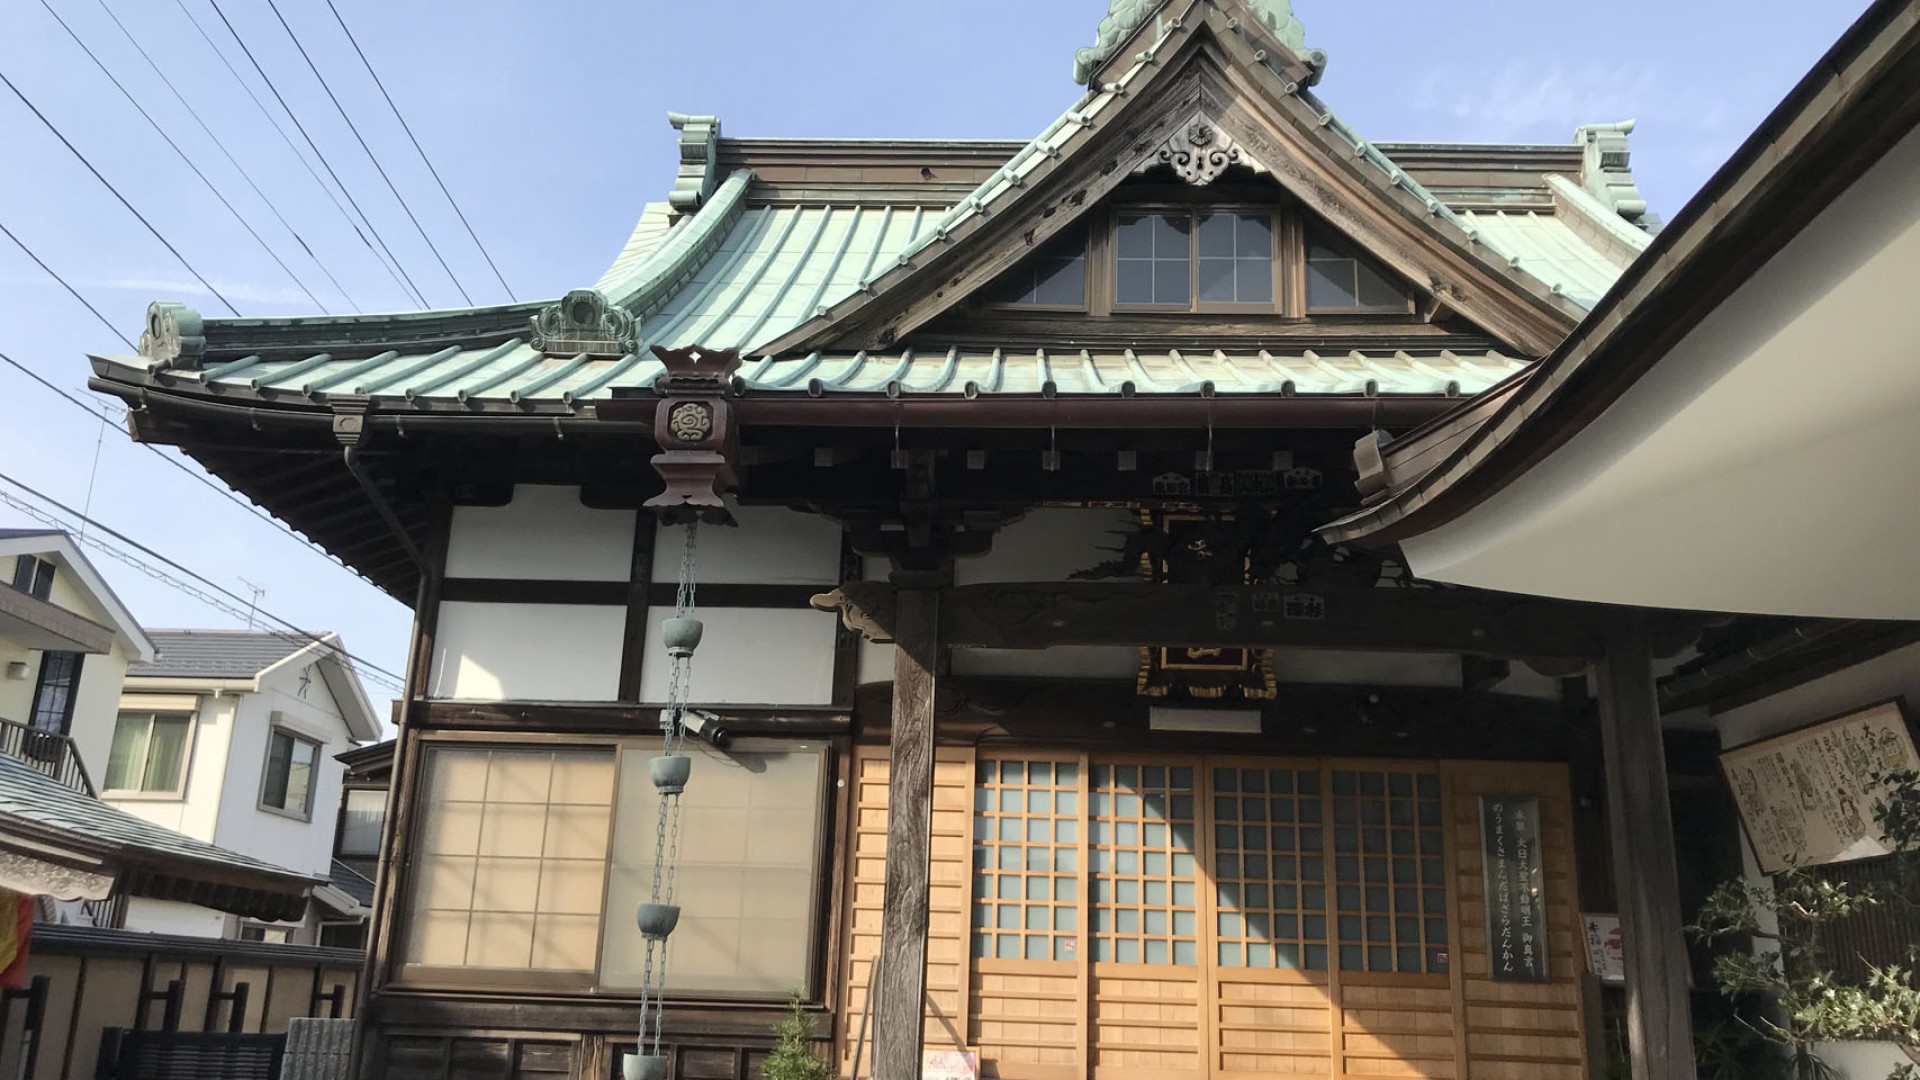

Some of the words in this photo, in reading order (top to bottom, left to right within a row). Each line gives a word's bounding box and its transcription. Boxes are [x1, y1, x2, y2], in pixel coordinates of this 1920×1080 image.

[1517, 837, 1533, 927] 大日大聖不動明王
[1522, 932, 1535, 968] 御真言
